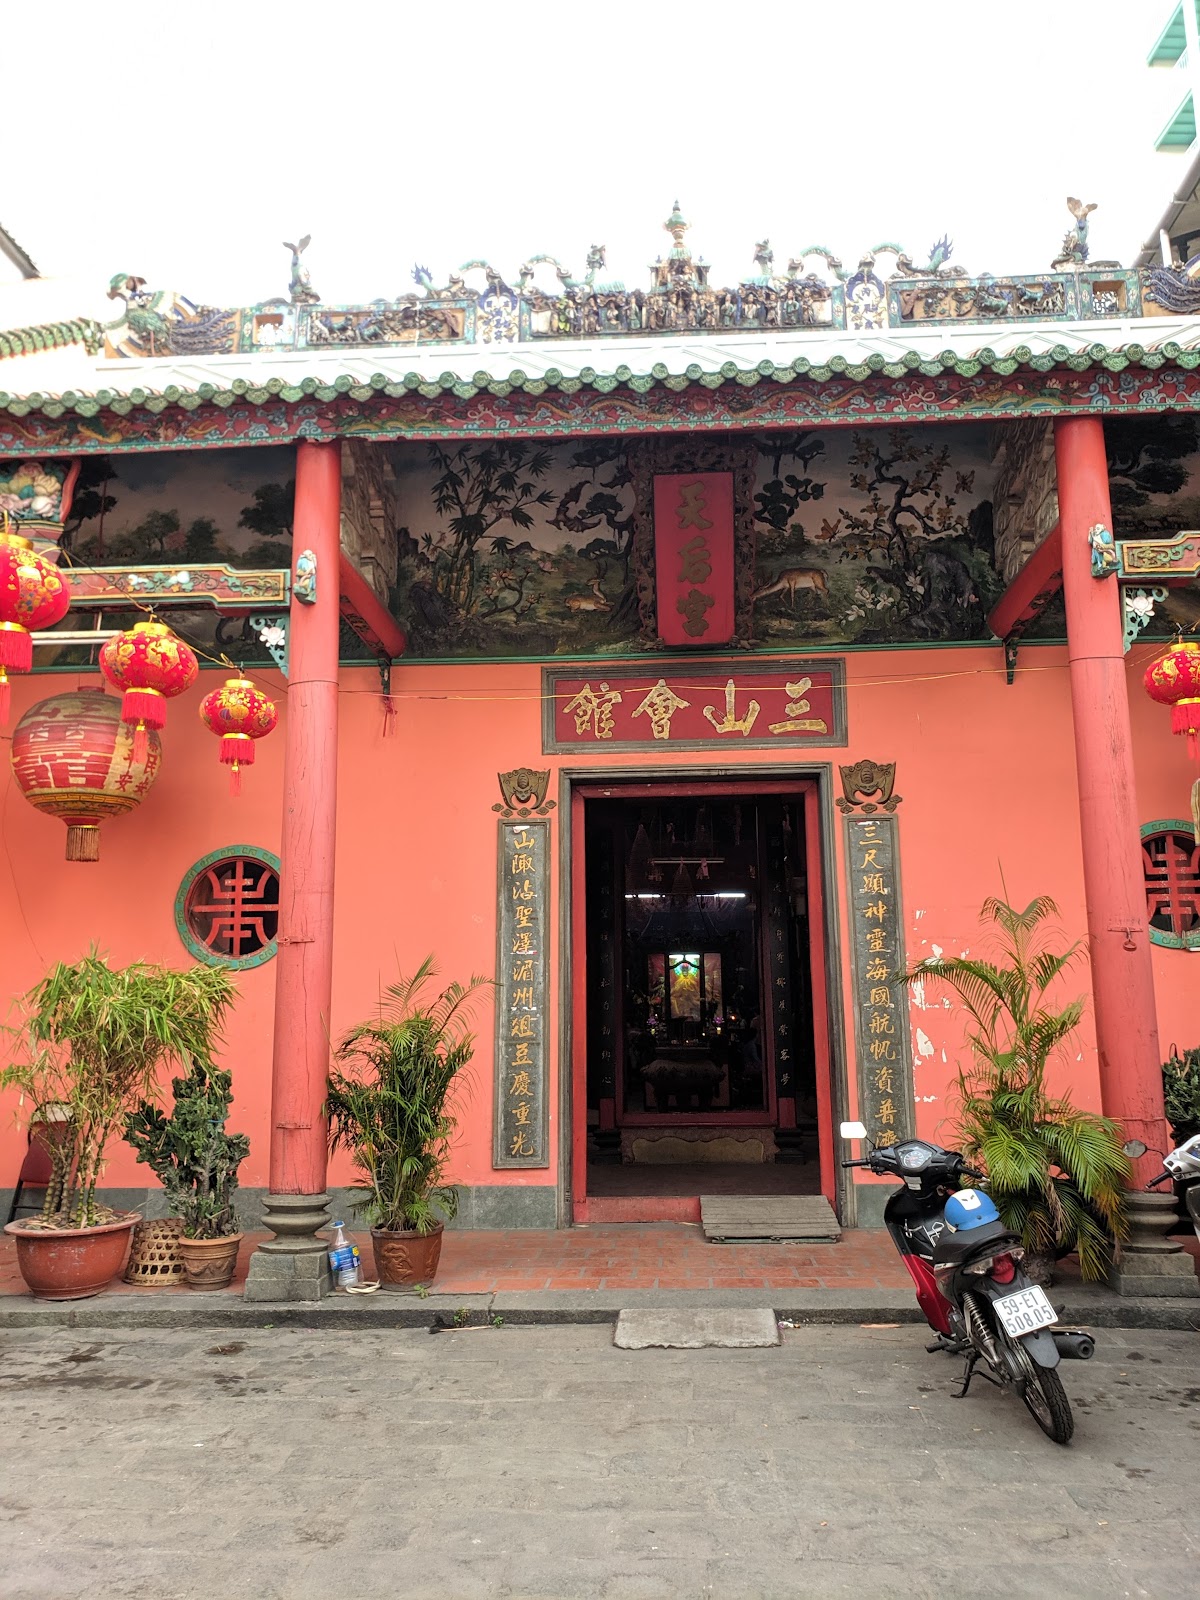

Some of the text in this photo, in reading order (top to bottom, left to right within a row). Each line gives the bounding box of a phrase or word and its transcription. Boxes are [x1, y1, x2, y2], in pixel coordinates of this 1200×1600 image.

[674, 480, 716, 638] 天后宮
[562, 676, 828, 740] 三山會館
[1001, 1291, 1040, 1316] 59-E1
[1005, 1305, 1053, 1334] 508.05
